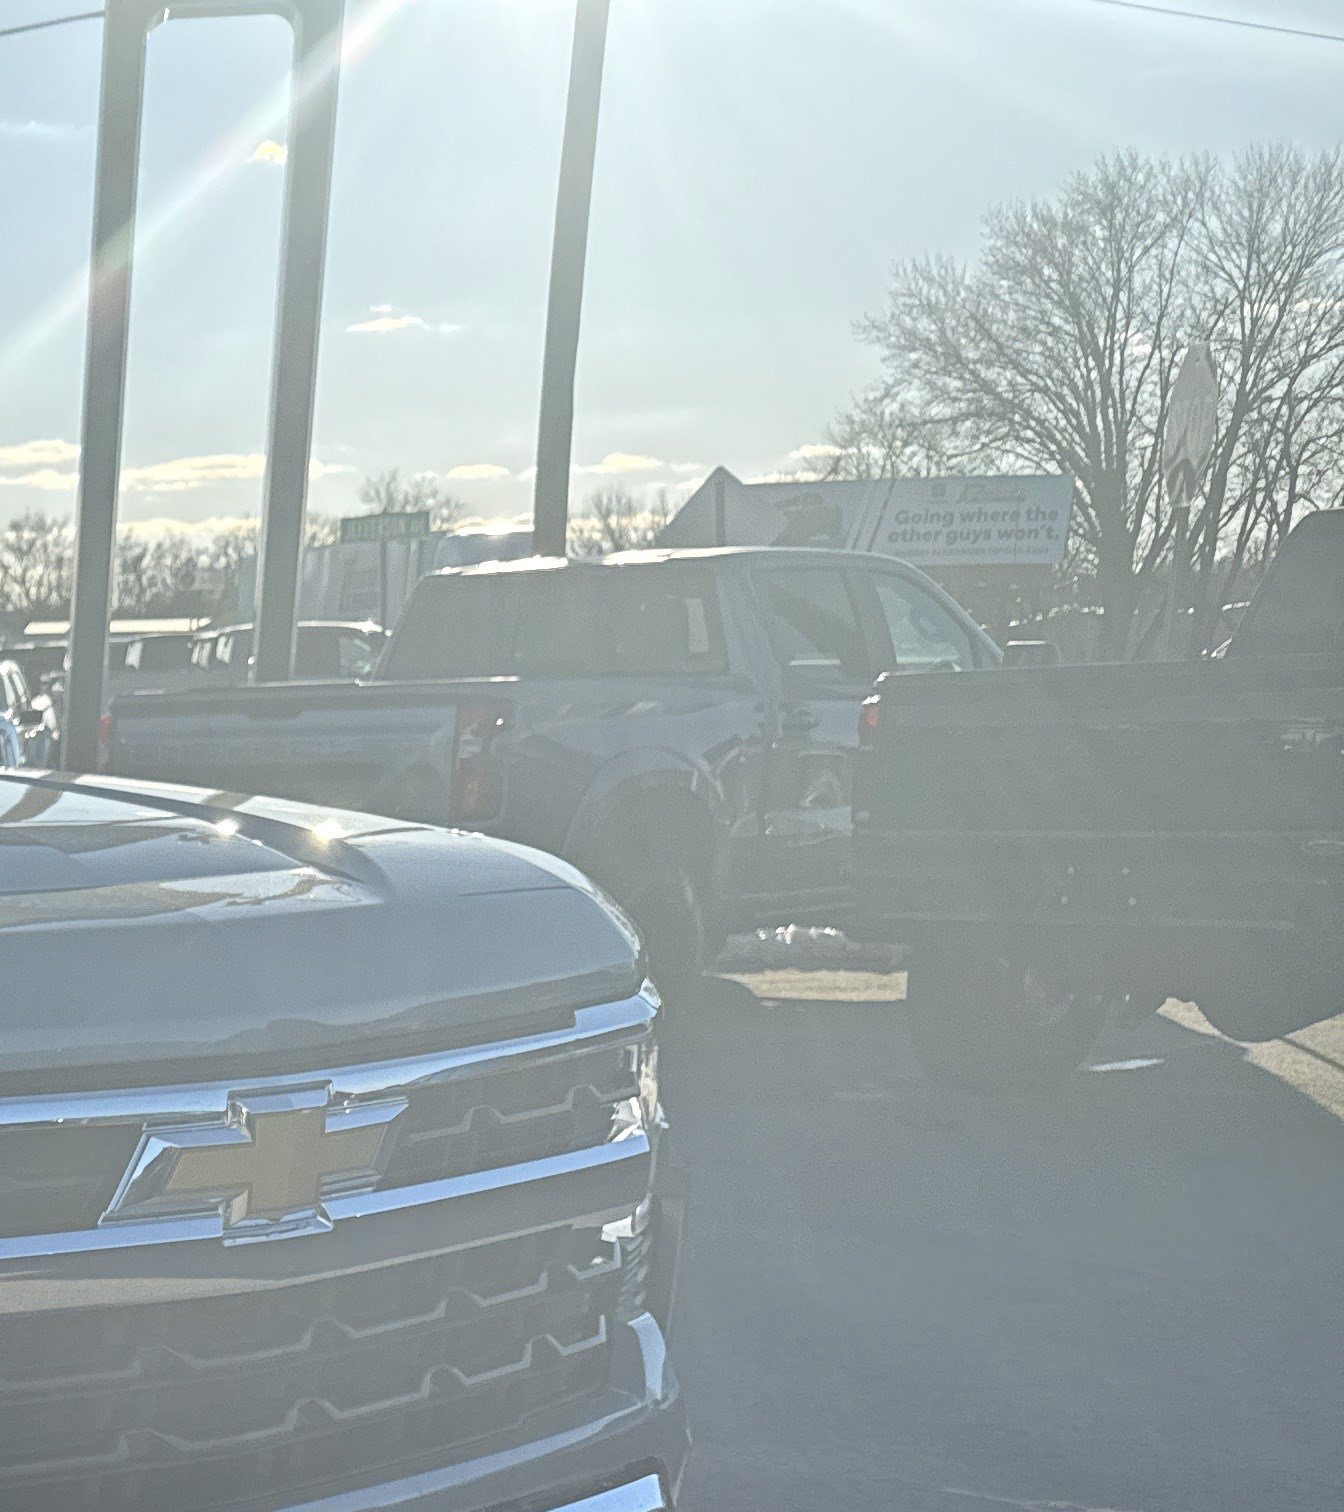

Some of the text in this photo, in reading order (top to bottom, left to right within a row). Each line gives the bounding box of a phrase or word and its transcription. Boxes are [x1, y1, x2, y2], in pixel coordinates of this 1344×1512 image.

[894, 503, 1059, 527] Going where the
[887, 527, 942, 543] other
[945, 527, 992, 545] guys
